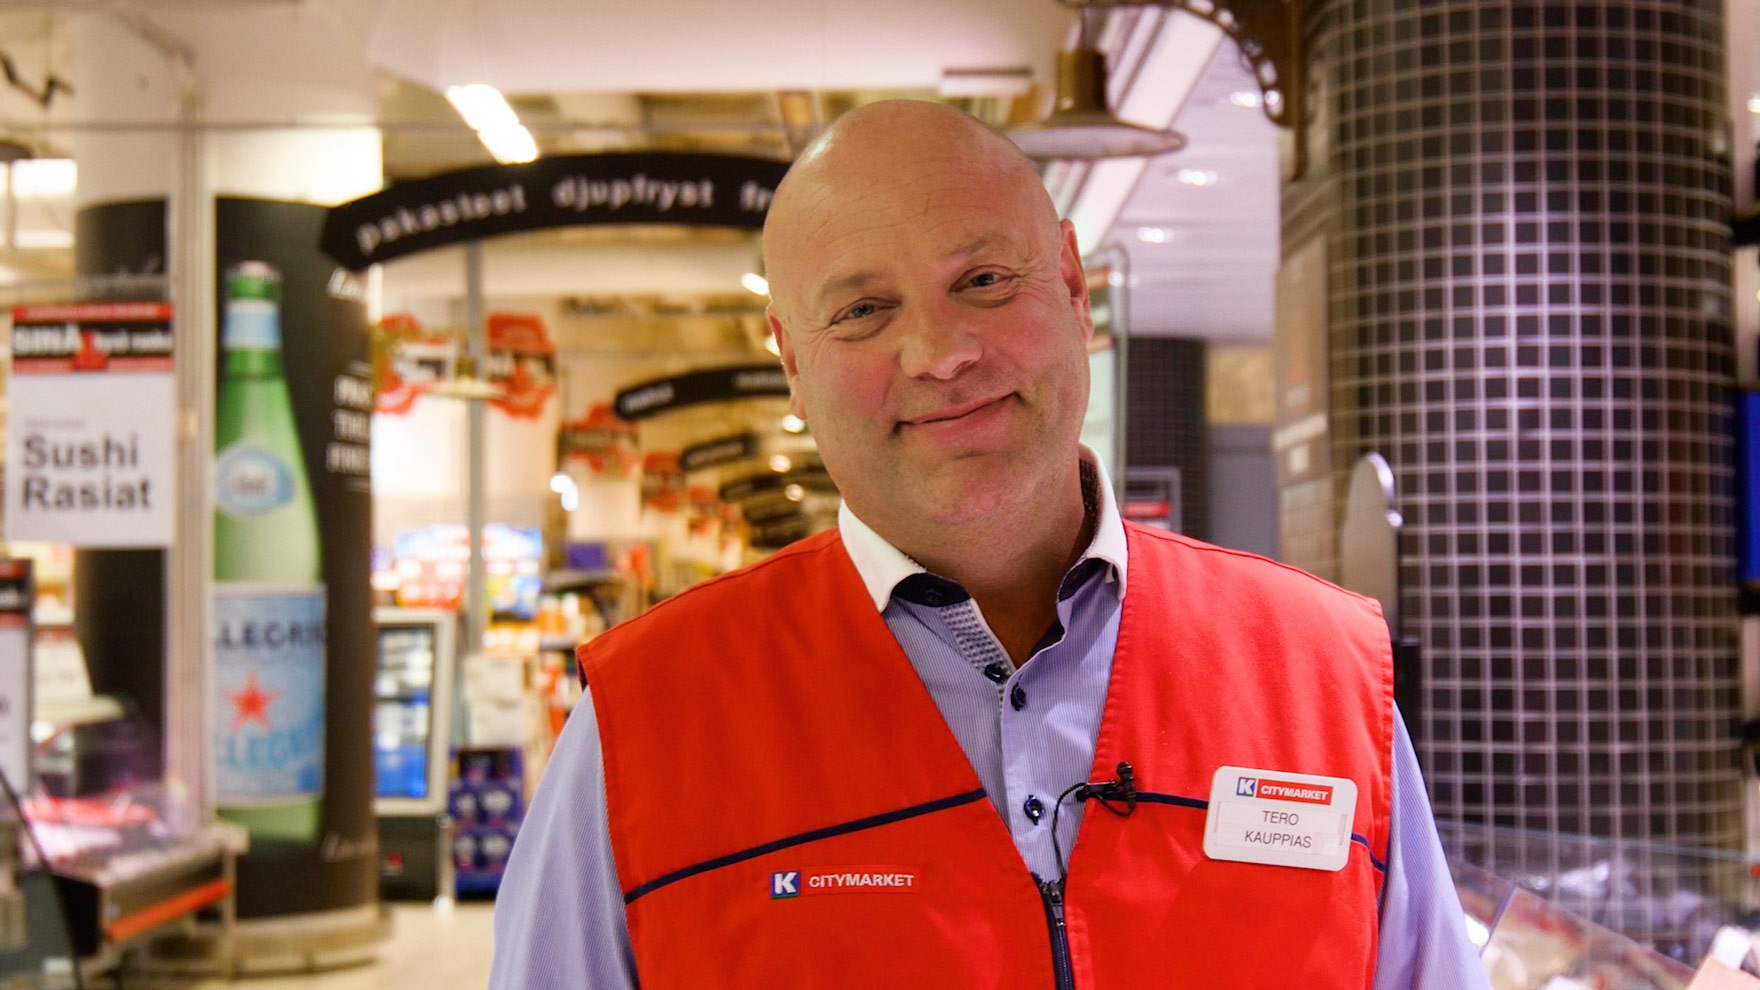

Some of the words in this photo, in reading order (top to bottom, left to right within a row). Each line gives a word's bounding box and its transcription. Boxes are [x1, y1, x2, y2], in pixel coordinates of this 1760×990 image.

[355, 182, 528, 257] pakasteet
[551, 173, 715, 213] djupfryst
[23, 432, 138, 470] Sushi
[22, 474, 152, 511] Rasiat
[1238, 777, 1256, 796] K
[1260, 784, 1329, 801] CITYMARKET
[1261, 809, 1300, 826] TERO
[1243, 829, 1313, 849] KAUPPIAS
[773, 871, 798, 895] K
[808, 872, 915, 888] CITYMARKET
